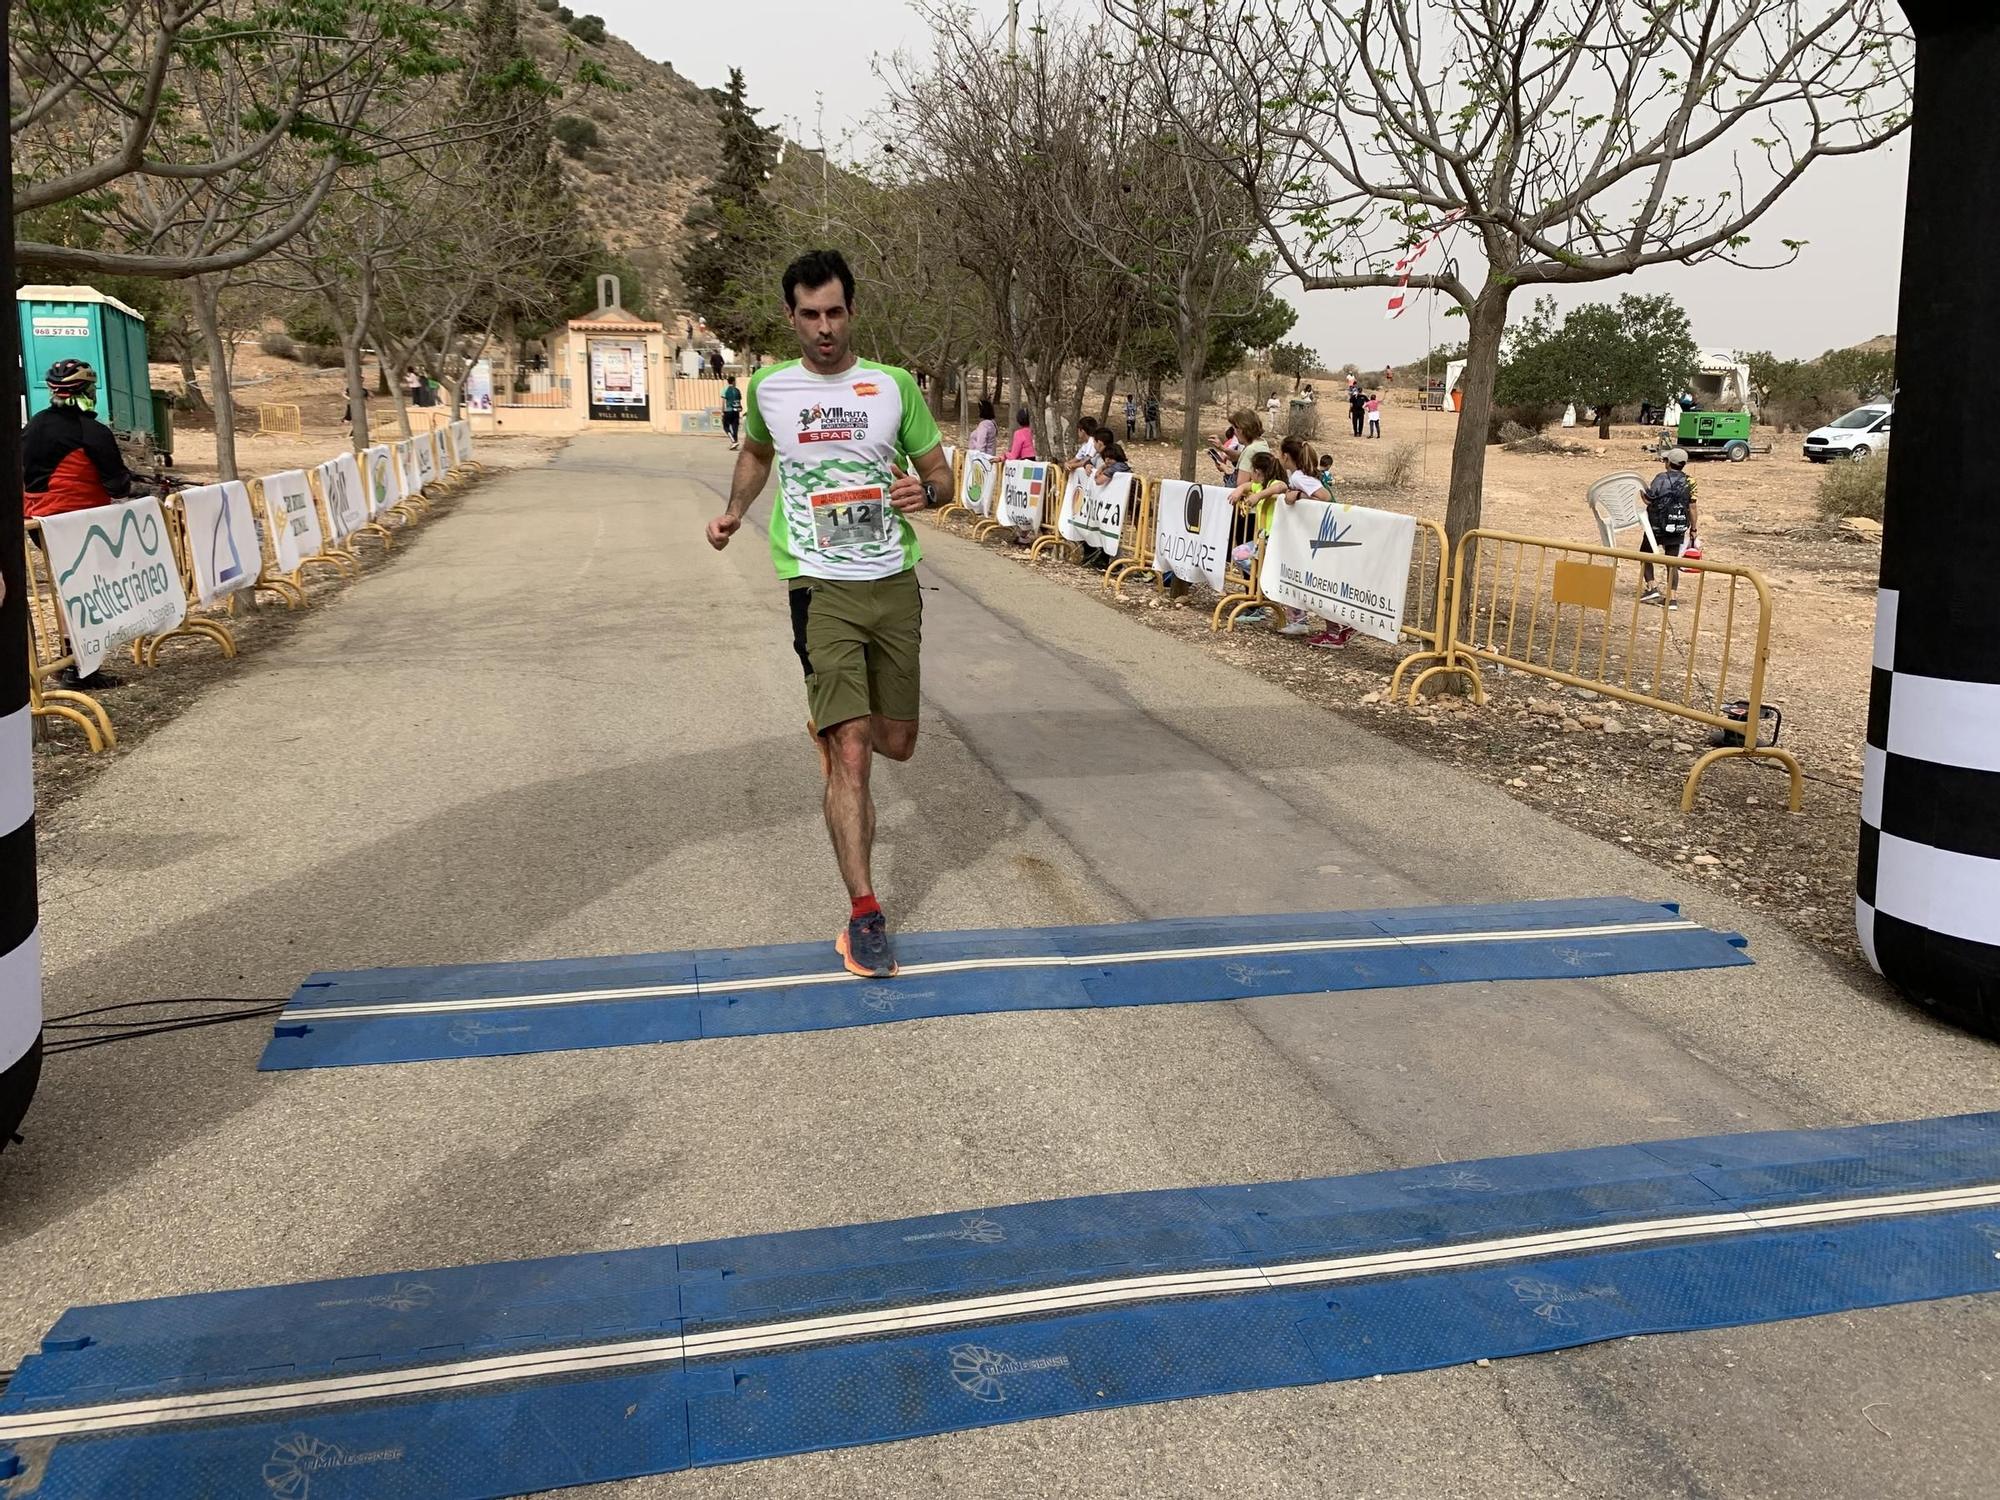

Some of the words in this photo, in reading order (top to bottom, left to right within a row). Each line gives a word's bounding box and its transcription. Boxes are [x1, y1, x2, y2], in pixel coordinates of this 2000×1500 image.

[821, 407, 843, 418] VIII
[810, 431, 851, 441] SPAR
[827, 505, 871, 527] 112
[1304, 571, 1339, 595] MORENO
[1340, 581, 1378, 607] MEROÑO
[1379, 596, 1396, 613] S.L.
[1278, 585, 1323, 609] SANIDAD
[1333, 604, 1395, 633] VEGETAL
